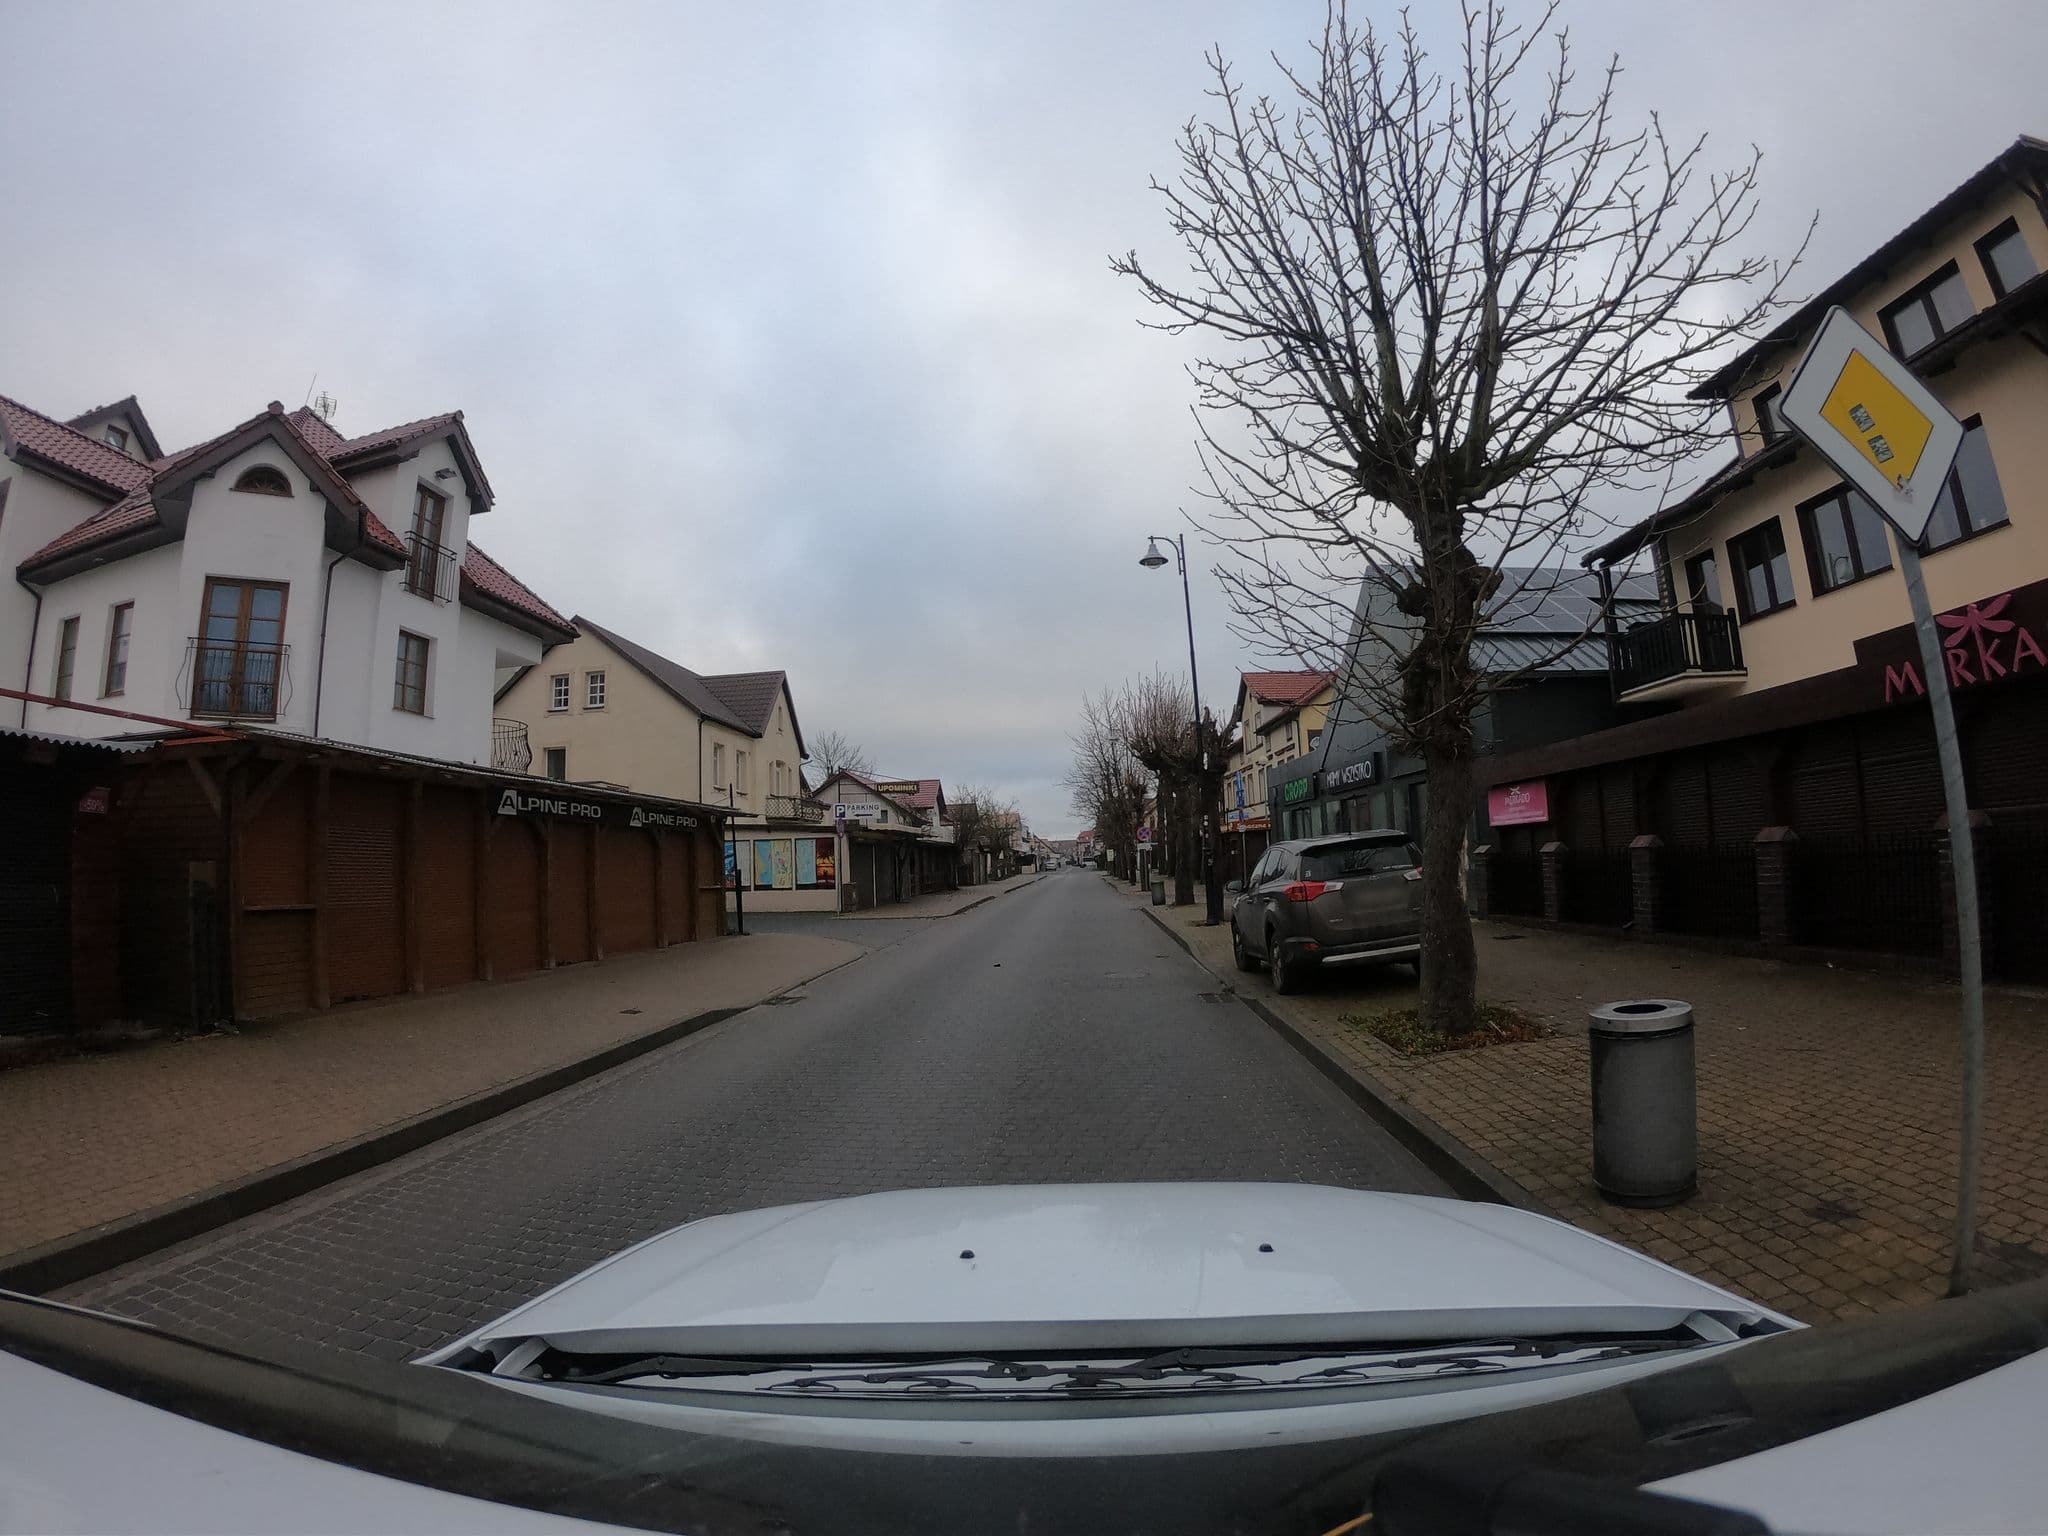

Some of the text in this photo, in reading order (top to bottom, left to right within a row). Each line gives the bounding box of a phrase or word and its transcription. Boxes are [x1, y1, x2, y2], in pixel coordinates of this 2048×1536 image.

[1884, 626, 2048, 705] MRKA
[497, 789, 601, 818] ALPINE PRO
[629, 806, 698, 828] ALPINE PRO
